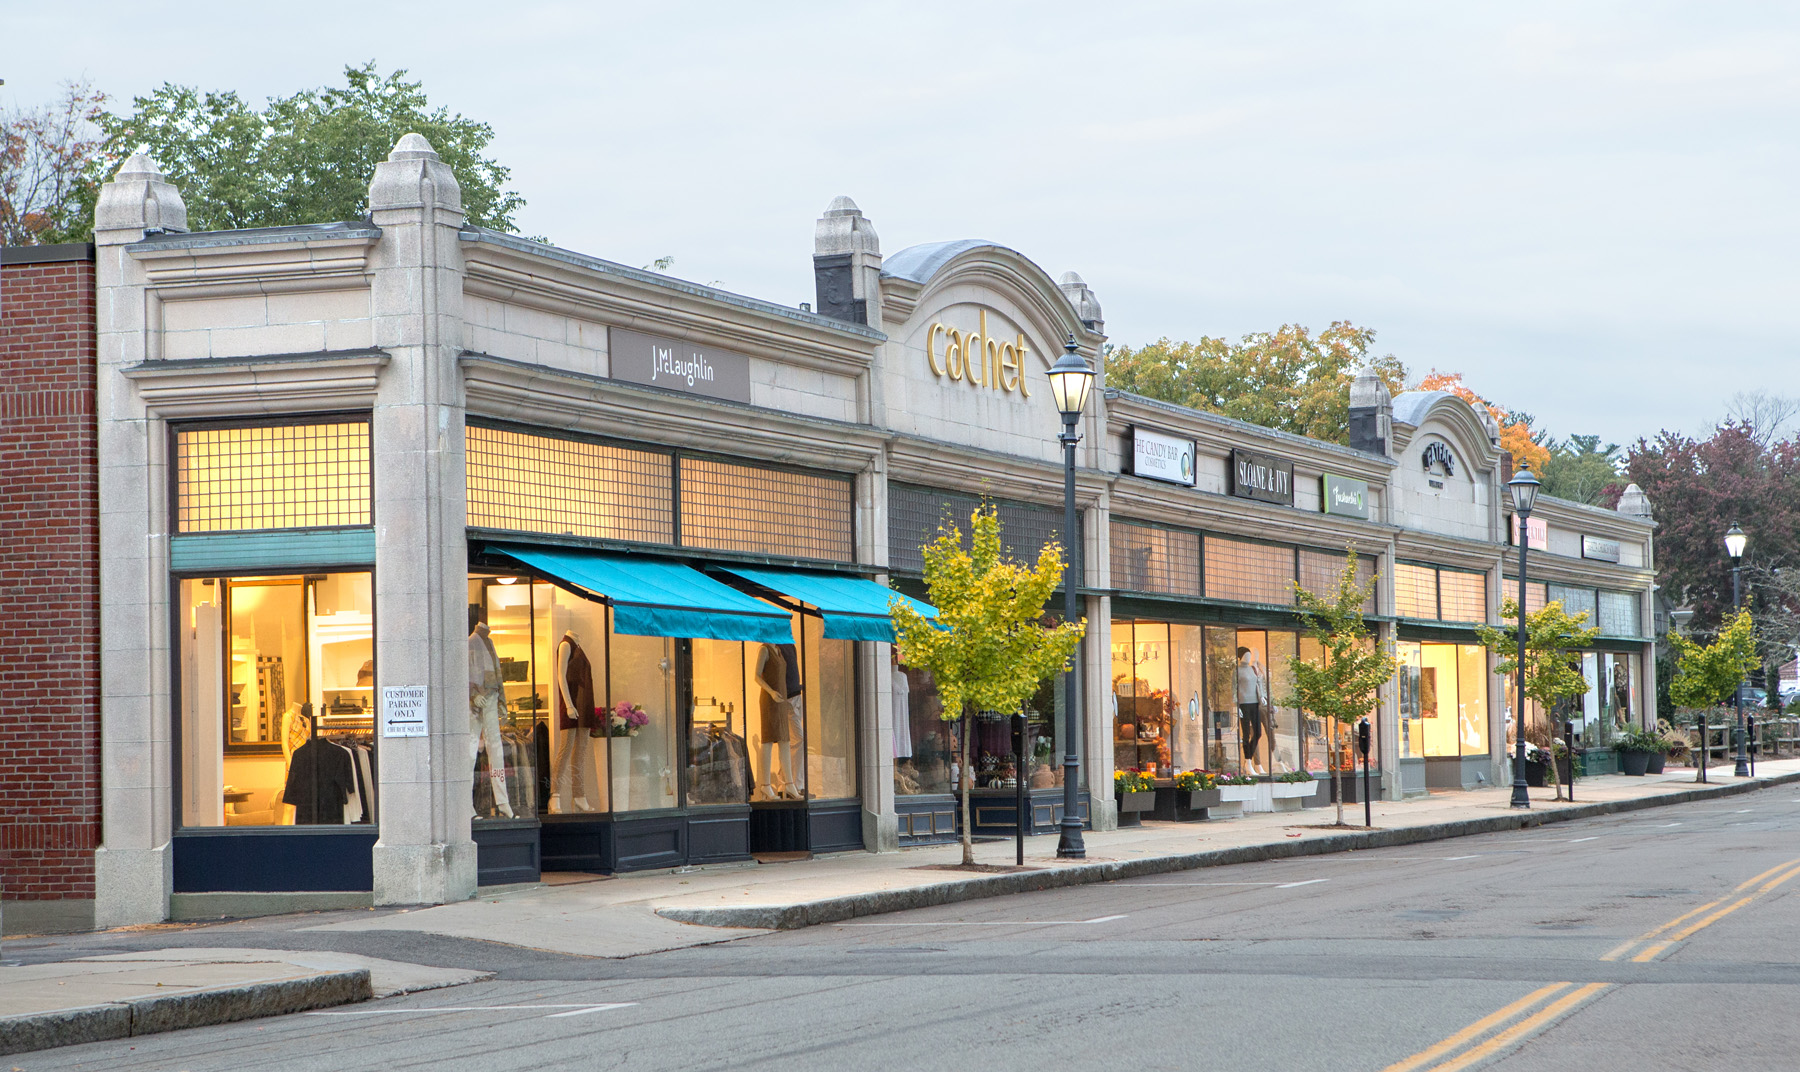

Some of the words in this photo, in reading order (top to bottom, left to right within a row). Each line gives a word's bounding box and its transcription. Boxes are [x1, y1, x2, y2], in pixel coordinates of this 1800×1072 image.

[926, 308, 1032, 398] cachet
[1135, 438, 1145, 454] THE
[1145, 440, 1167, 458] CANDY
[1167, 445, 1179, 461] BAR
[1239, 460, 1266, 490] SLOANE
[1268, 468, 1274, 492] &
[1276, 469, 1289, 495] IVY
[385, 689, 424, 699] CUSTOMER
[388, 699, 422, 709] PARKING
[394, 709, 416, 718] ONLY
